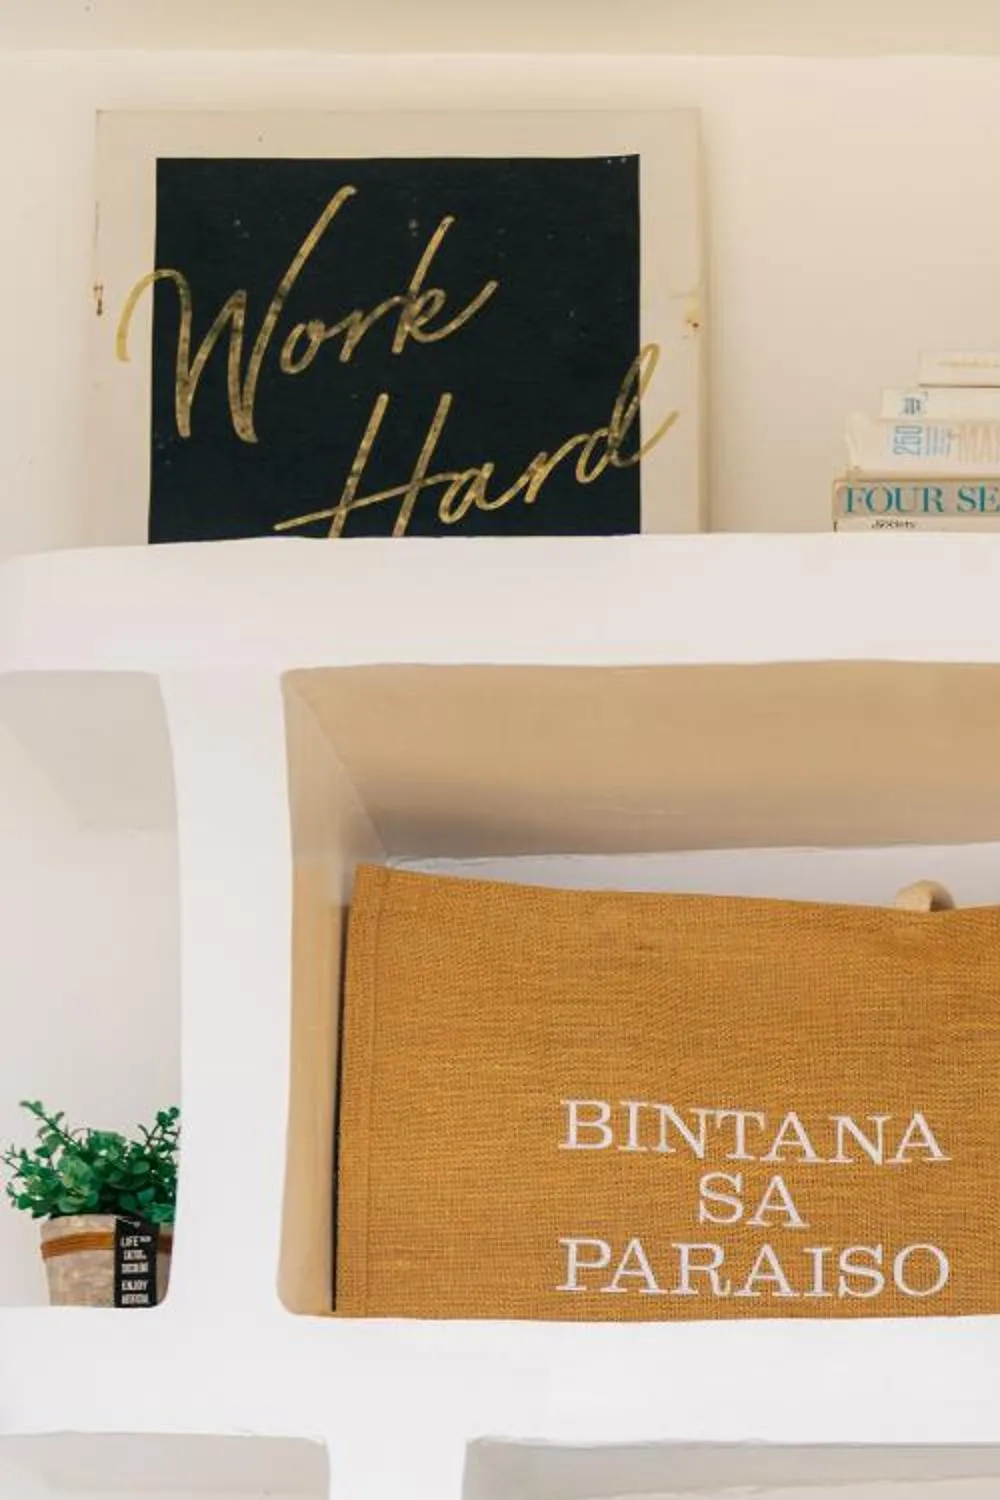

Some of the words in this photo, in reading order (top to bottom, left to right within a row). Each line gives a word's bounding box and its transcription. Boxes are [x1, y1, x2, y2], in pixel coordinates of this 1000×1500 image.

[116, 185, 498, 442] Work
[273, 343, 679, 538] Hard
[845, 484, 945, 513] FOUR
[558, 1099, 952, 1165] BINTANA
[698, 1171, 810, 1228] SA
[556, 1237, 950, 1298] PARAISO
